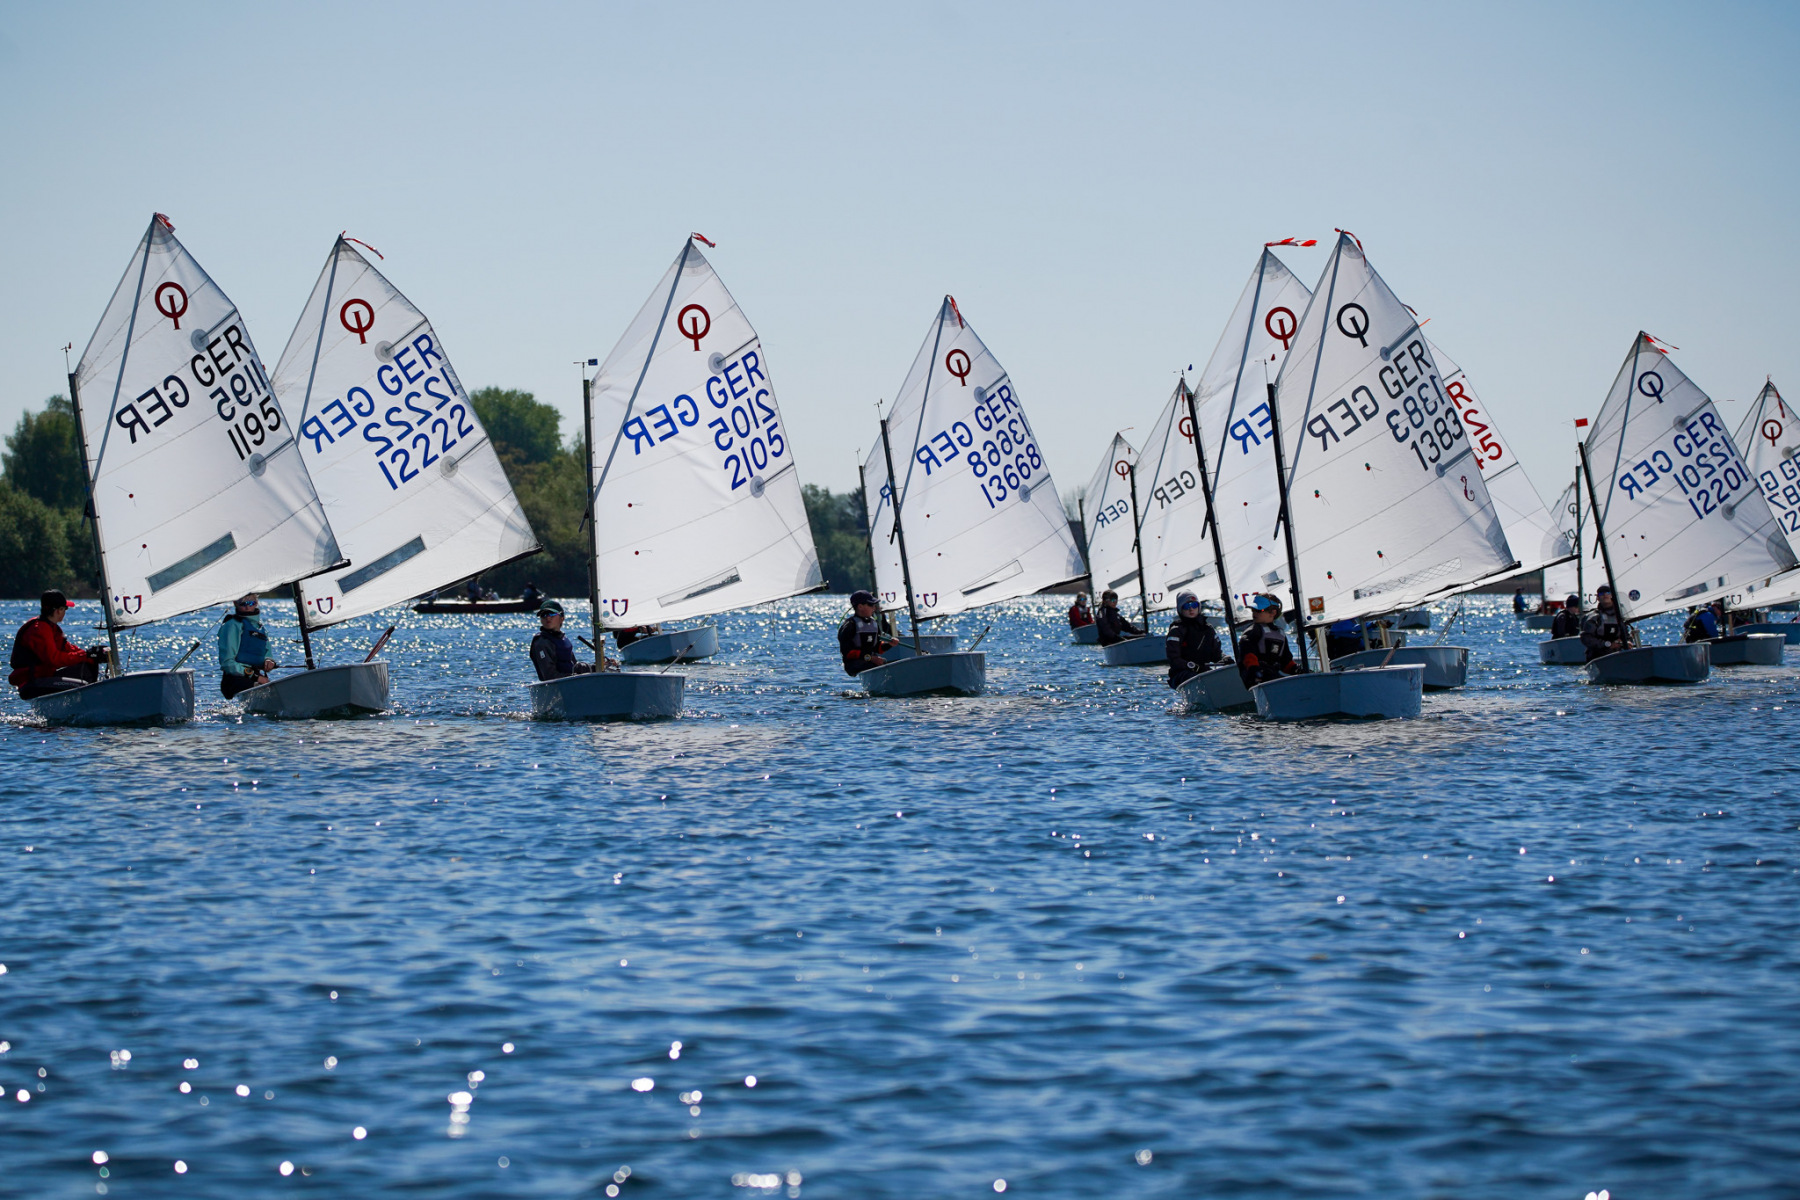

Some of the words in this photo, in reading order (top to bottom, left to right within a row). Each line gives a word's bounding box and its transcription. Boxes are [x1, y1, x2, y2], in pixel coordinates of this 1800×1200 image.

[191, 325, 251, 387] GER
[377, 334, 442, 396] GER
[706, 350, 765, 409] GER
[1378, 339, 1432, 399] GER
[227, 395, 281, 461] 1195
[974, 384, 1019, 432] GER
[1410, 407, 1464, 471] 1383
[1673, 412, 1722, 458] GER
[378, 404, 474, 490] 12222
[724, 421, 785, 491] 2105
[981, 443, 1042, 509] 13668
[1688, 460, 1749, 520] 12201
[1777, 505, 1800, 536] 12
